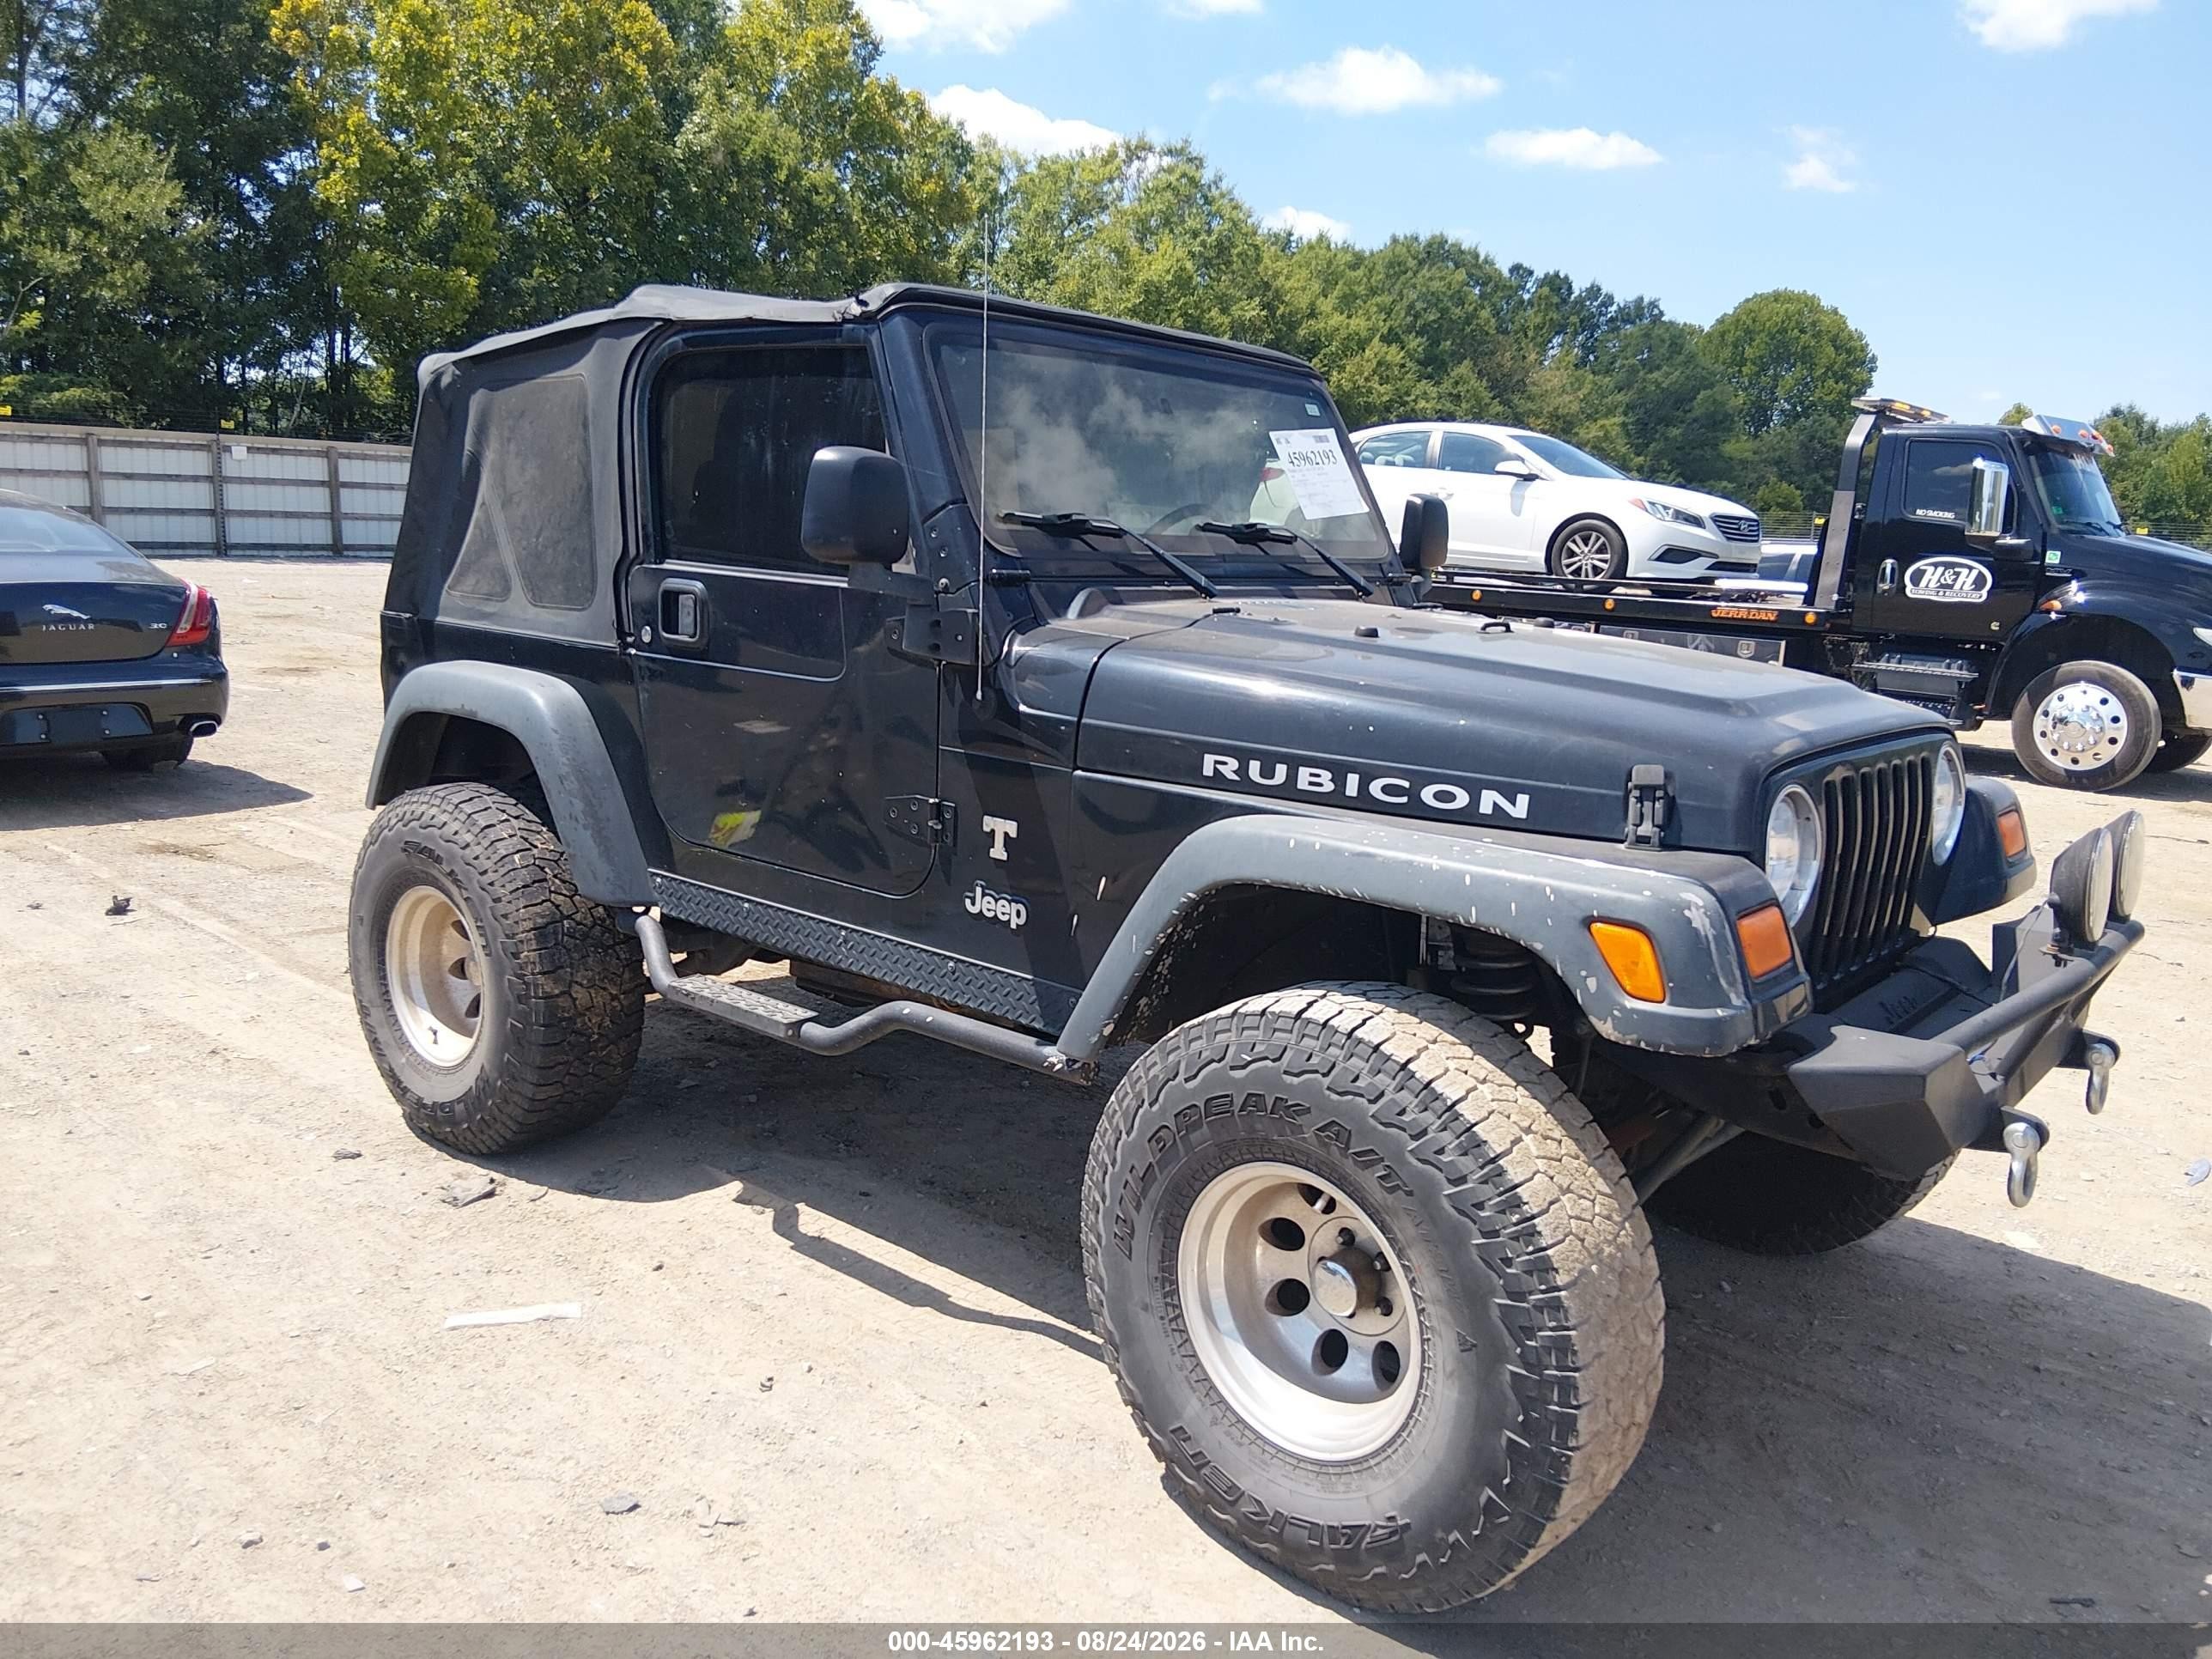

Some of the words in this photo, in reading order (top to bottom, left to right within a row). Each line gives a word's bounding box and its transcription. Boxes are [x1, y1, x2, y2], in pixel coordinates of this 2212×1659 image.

[1287, 449, 1338, 467] 45962193
[1918, 565, 1979, 592] H&H
[42, 623, 95, 631] JAGUAR
[1202, 753, 1531, 819] RUBICON
[982, 815, 1018, 861] T
[963, 883, 1028, 930] Jeep
[1113, 1091, 1312, 1261] WILDPEAK
[1169, 1425, 1412, 1549] FALKEN
